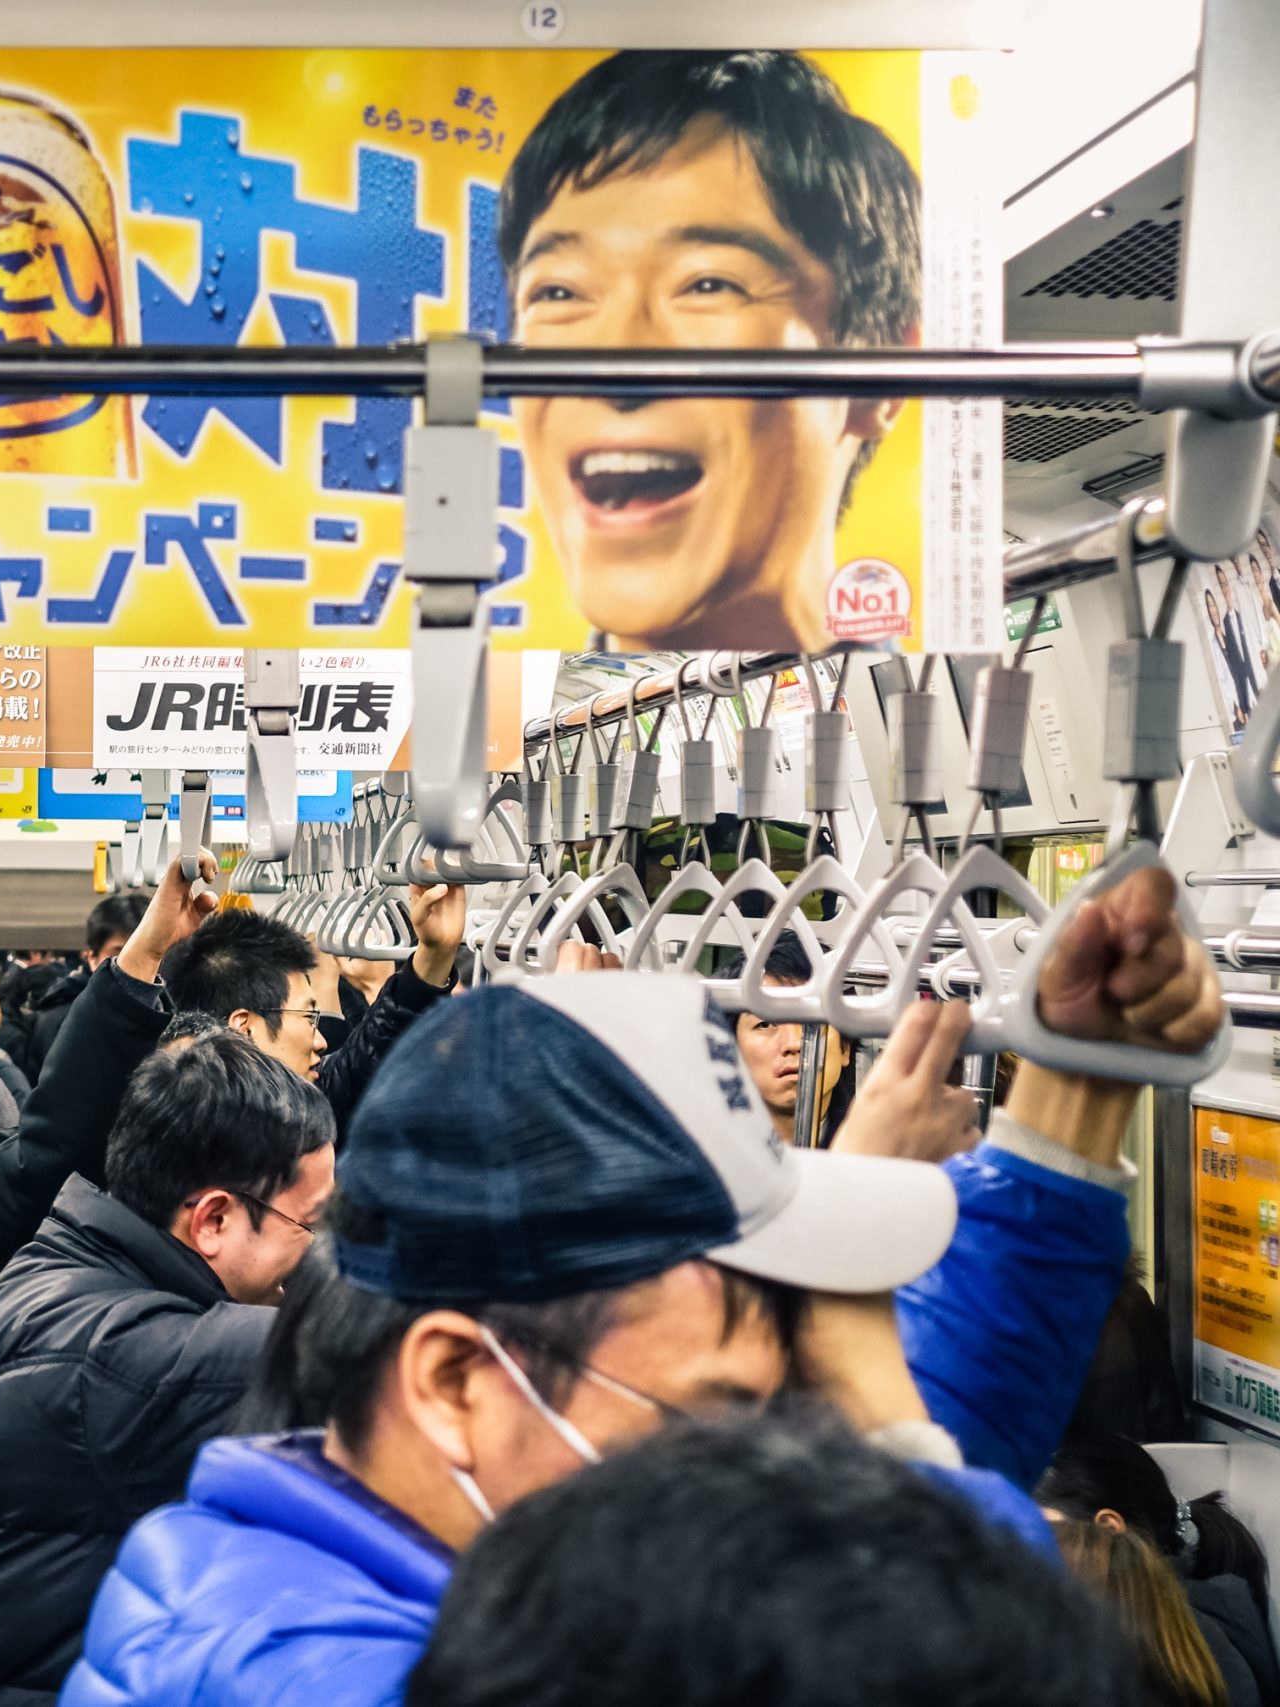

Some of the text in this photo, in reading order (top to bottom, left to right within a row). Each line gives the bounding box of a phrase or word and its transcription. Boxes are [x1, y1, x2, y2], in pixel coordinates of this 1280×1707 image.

[529, 7, 557, 28] 12
[453, 86, 498, 120] また
[362, 104, 506, 154] もらっちゃう!
